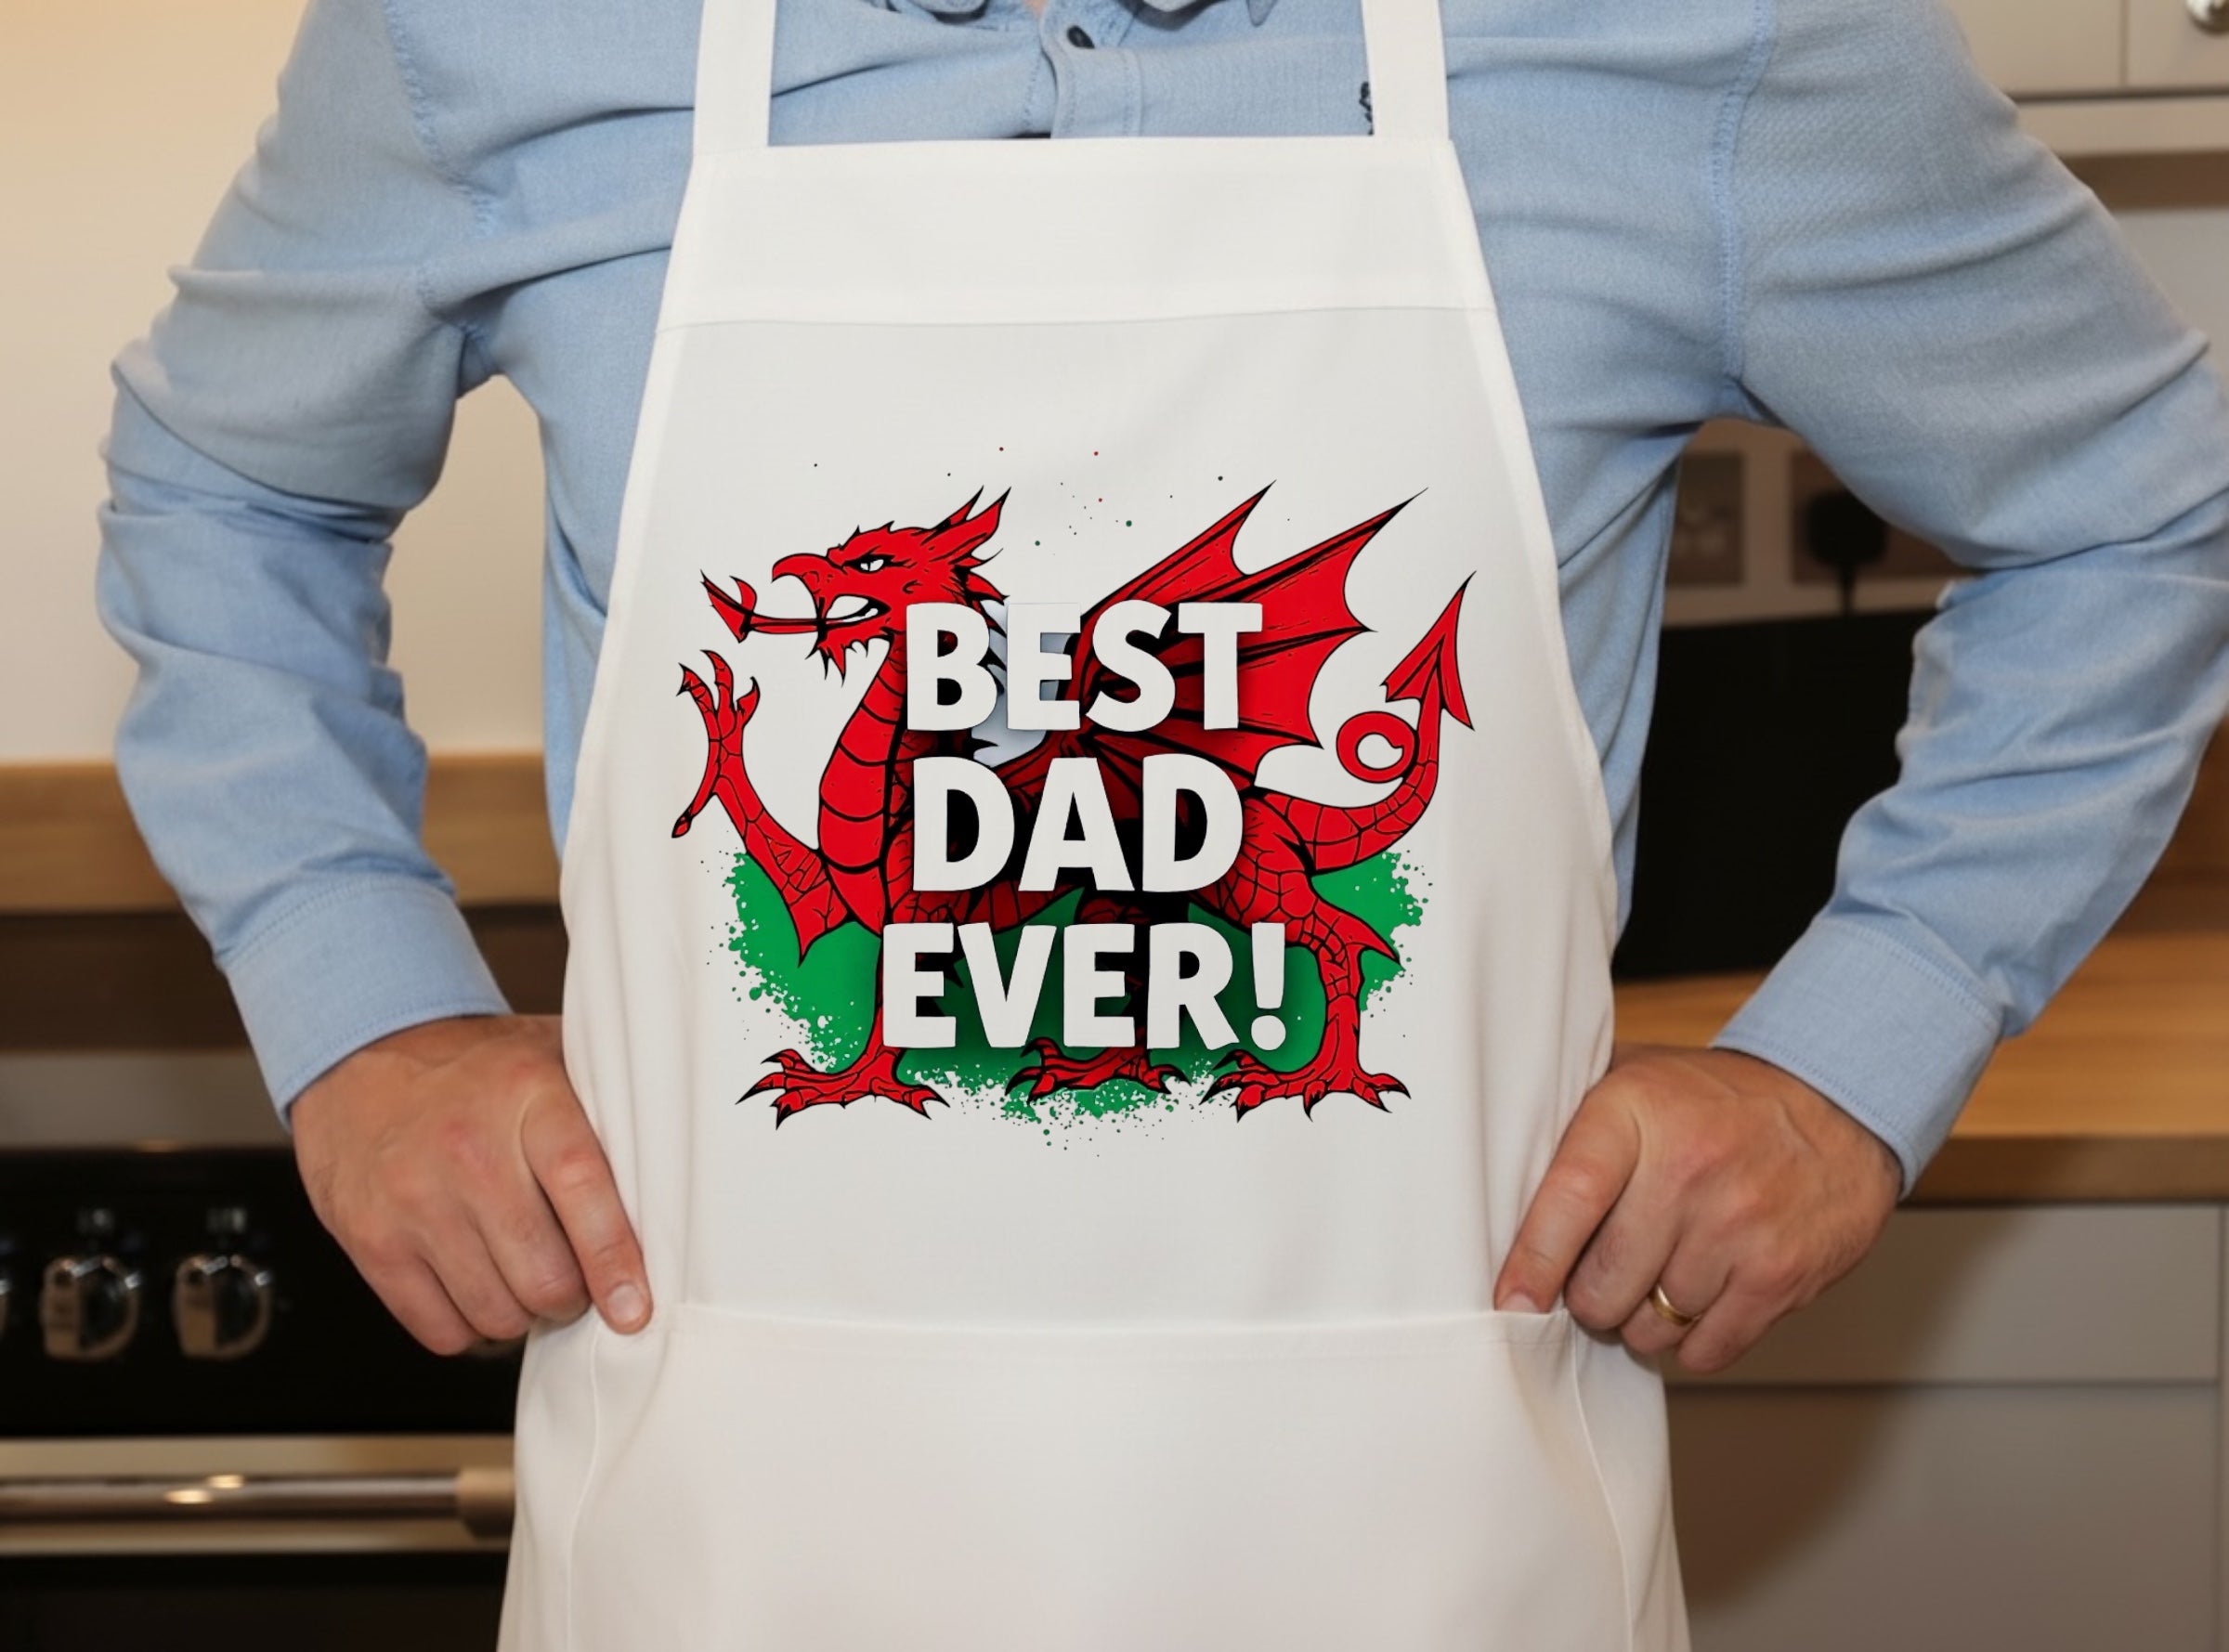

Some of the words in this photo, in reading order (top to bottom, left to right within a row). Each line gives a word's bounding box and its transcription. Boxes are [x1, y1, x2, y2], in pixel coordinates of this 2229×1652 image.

[906, 599, 1263, 733] BEST
[912, 753, 1244, 893] DAD
[882, 921, 1287, 1051] EVER!
